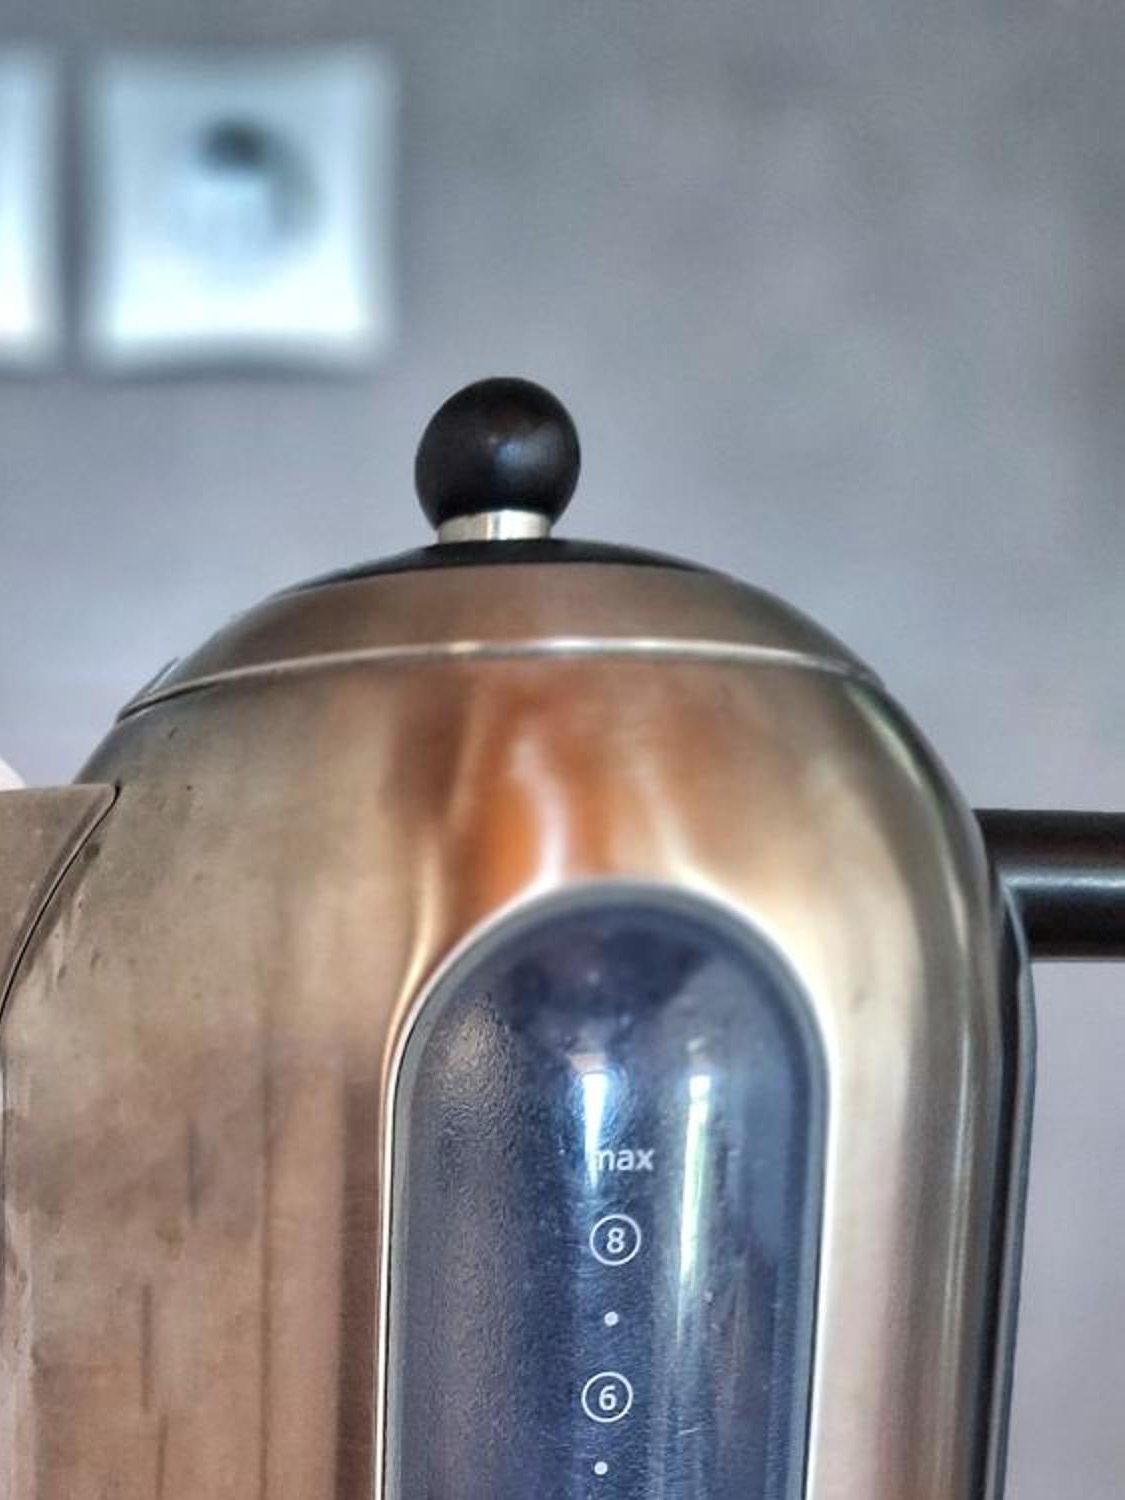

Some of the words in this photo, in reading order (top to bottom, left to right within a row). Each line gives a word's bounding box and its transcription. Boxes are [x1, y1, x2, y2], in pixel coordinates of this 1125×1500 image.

[587, 1148, 655, 1171] max
[606, 1227, 625, 1254] 8
[598, 1385, 617, 1411] 6
